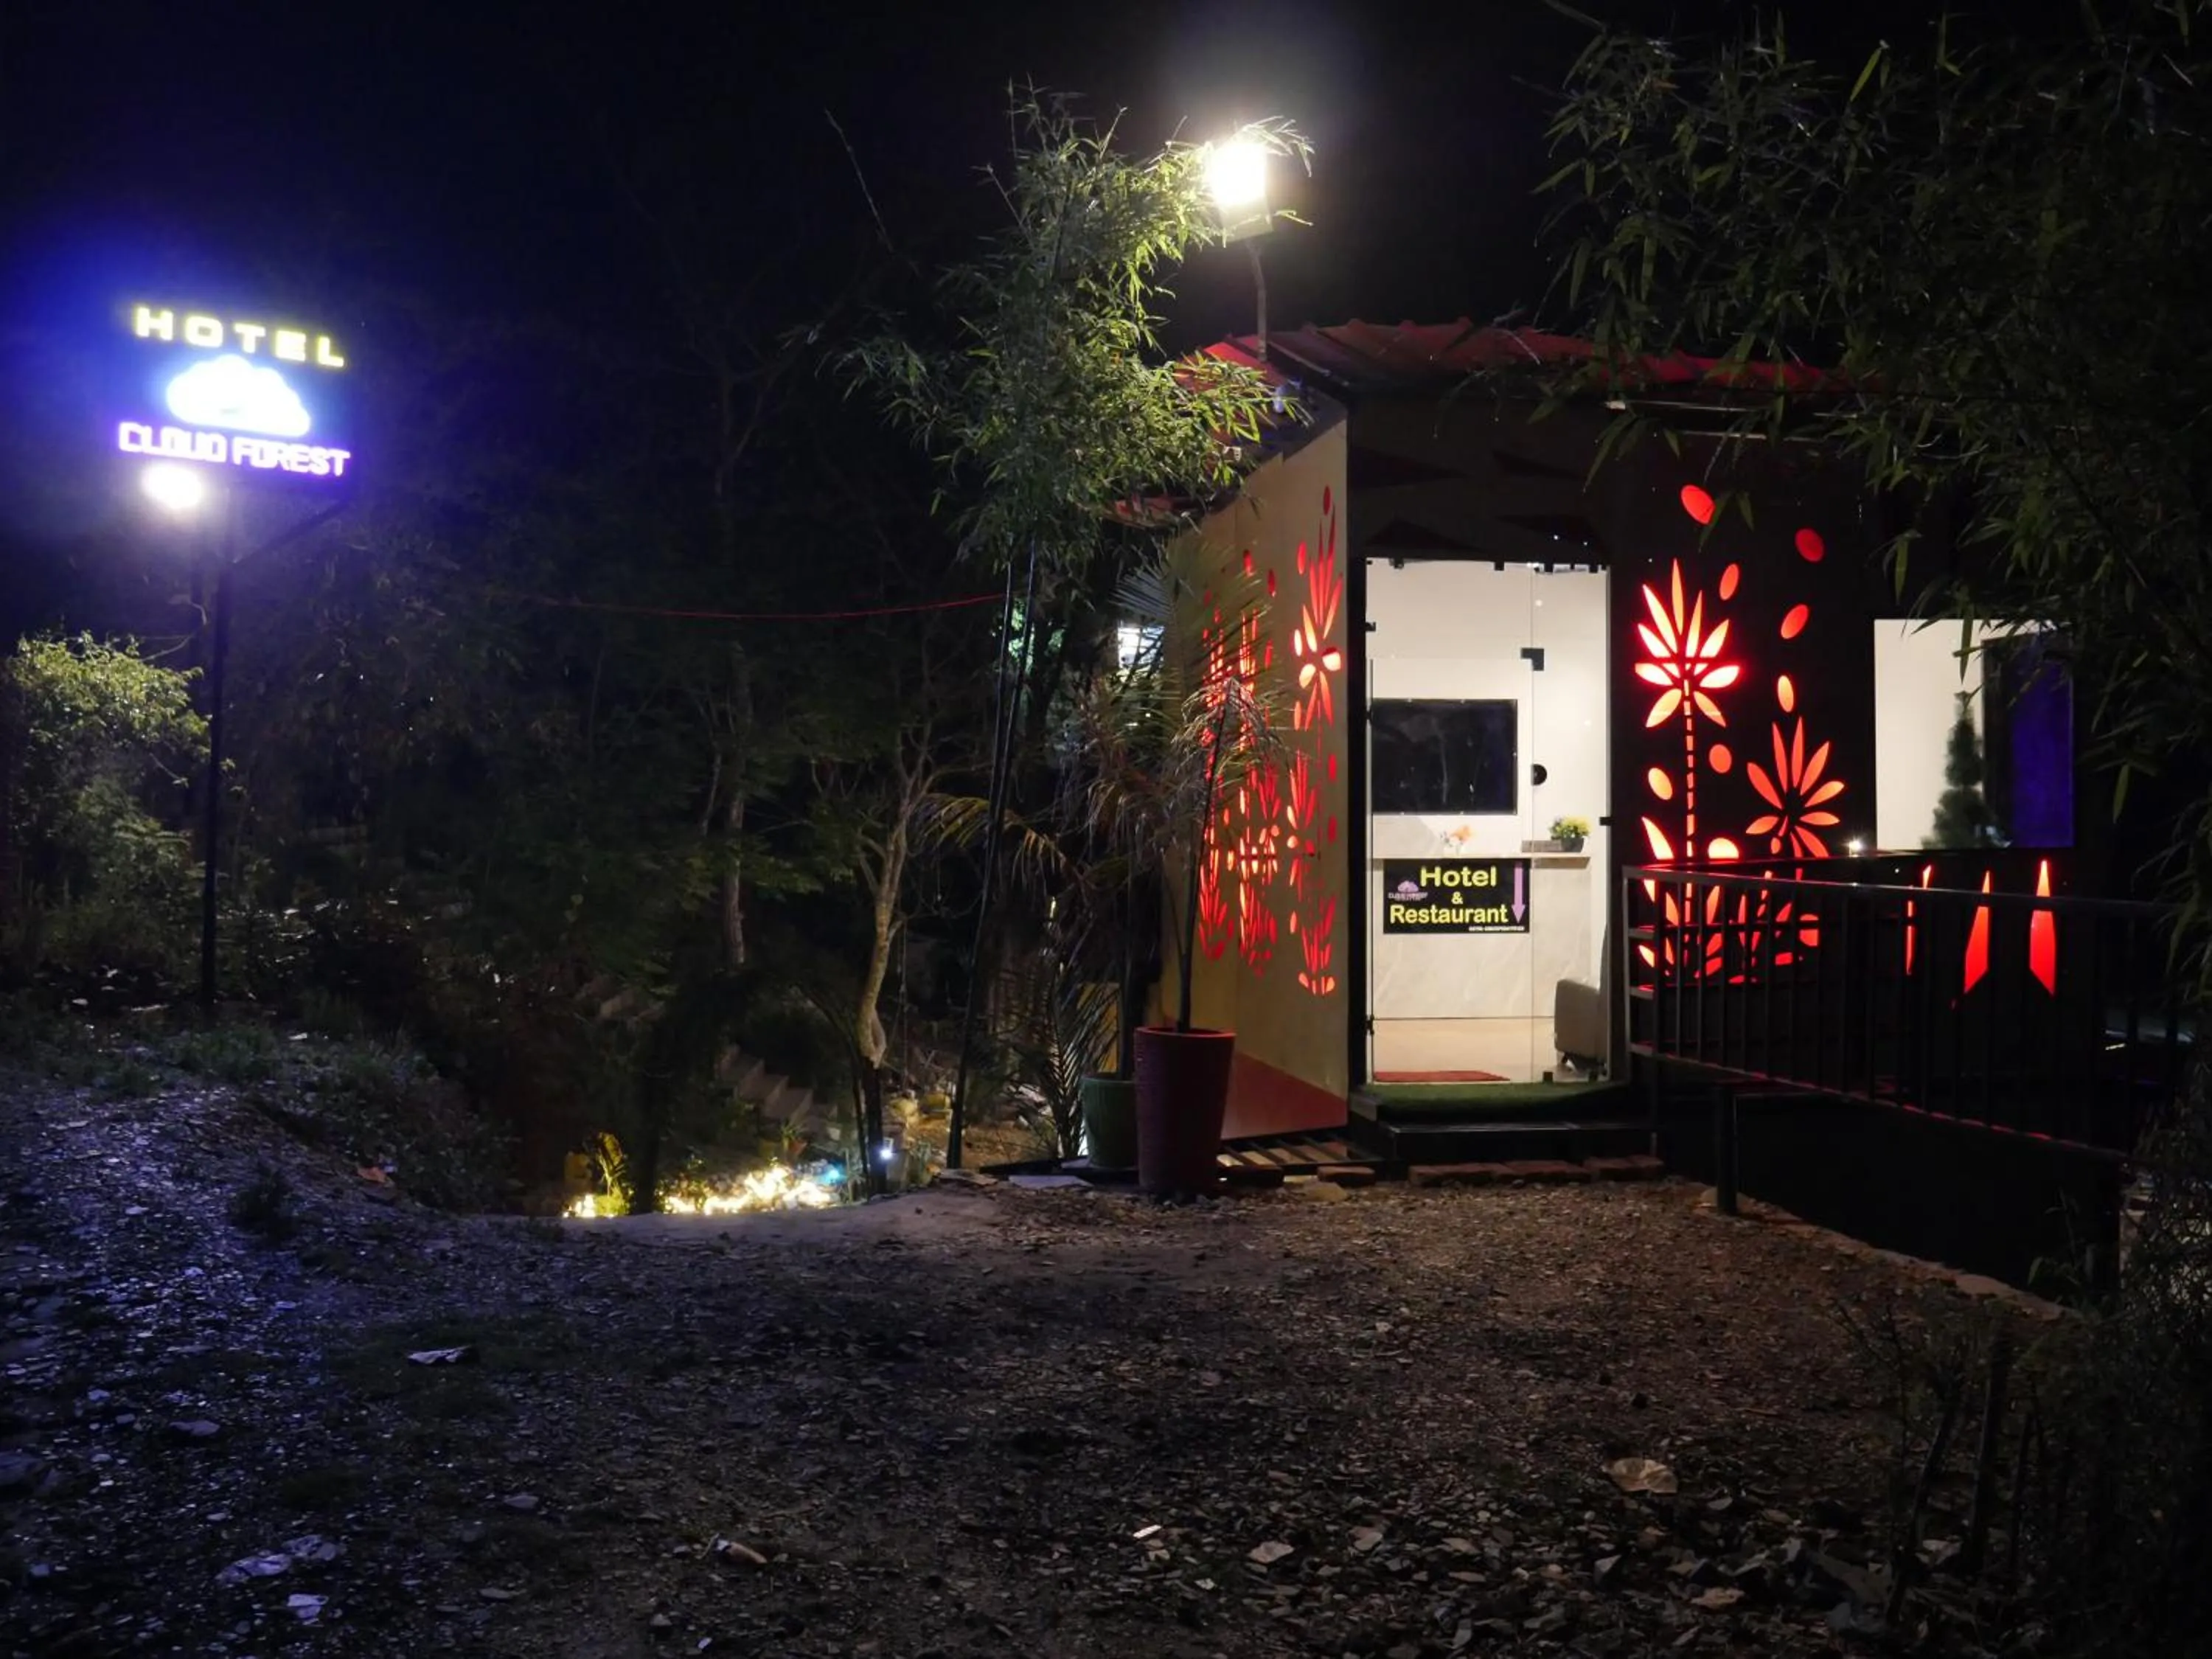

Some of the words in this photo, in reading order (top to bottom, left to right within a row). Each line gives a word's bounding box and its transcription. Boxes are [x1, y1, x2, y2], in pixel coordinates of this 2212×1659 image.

[134, 305, 345, 367] HOTEL
[119, 421, 228, 463] CLOUD
[232, 436, 351, 476] FOREST
[1420, 866, 1498, 888] Hotel
[1450, 891, 1464, 905] &
[1390, 904, 1509, 925] Restaurant
